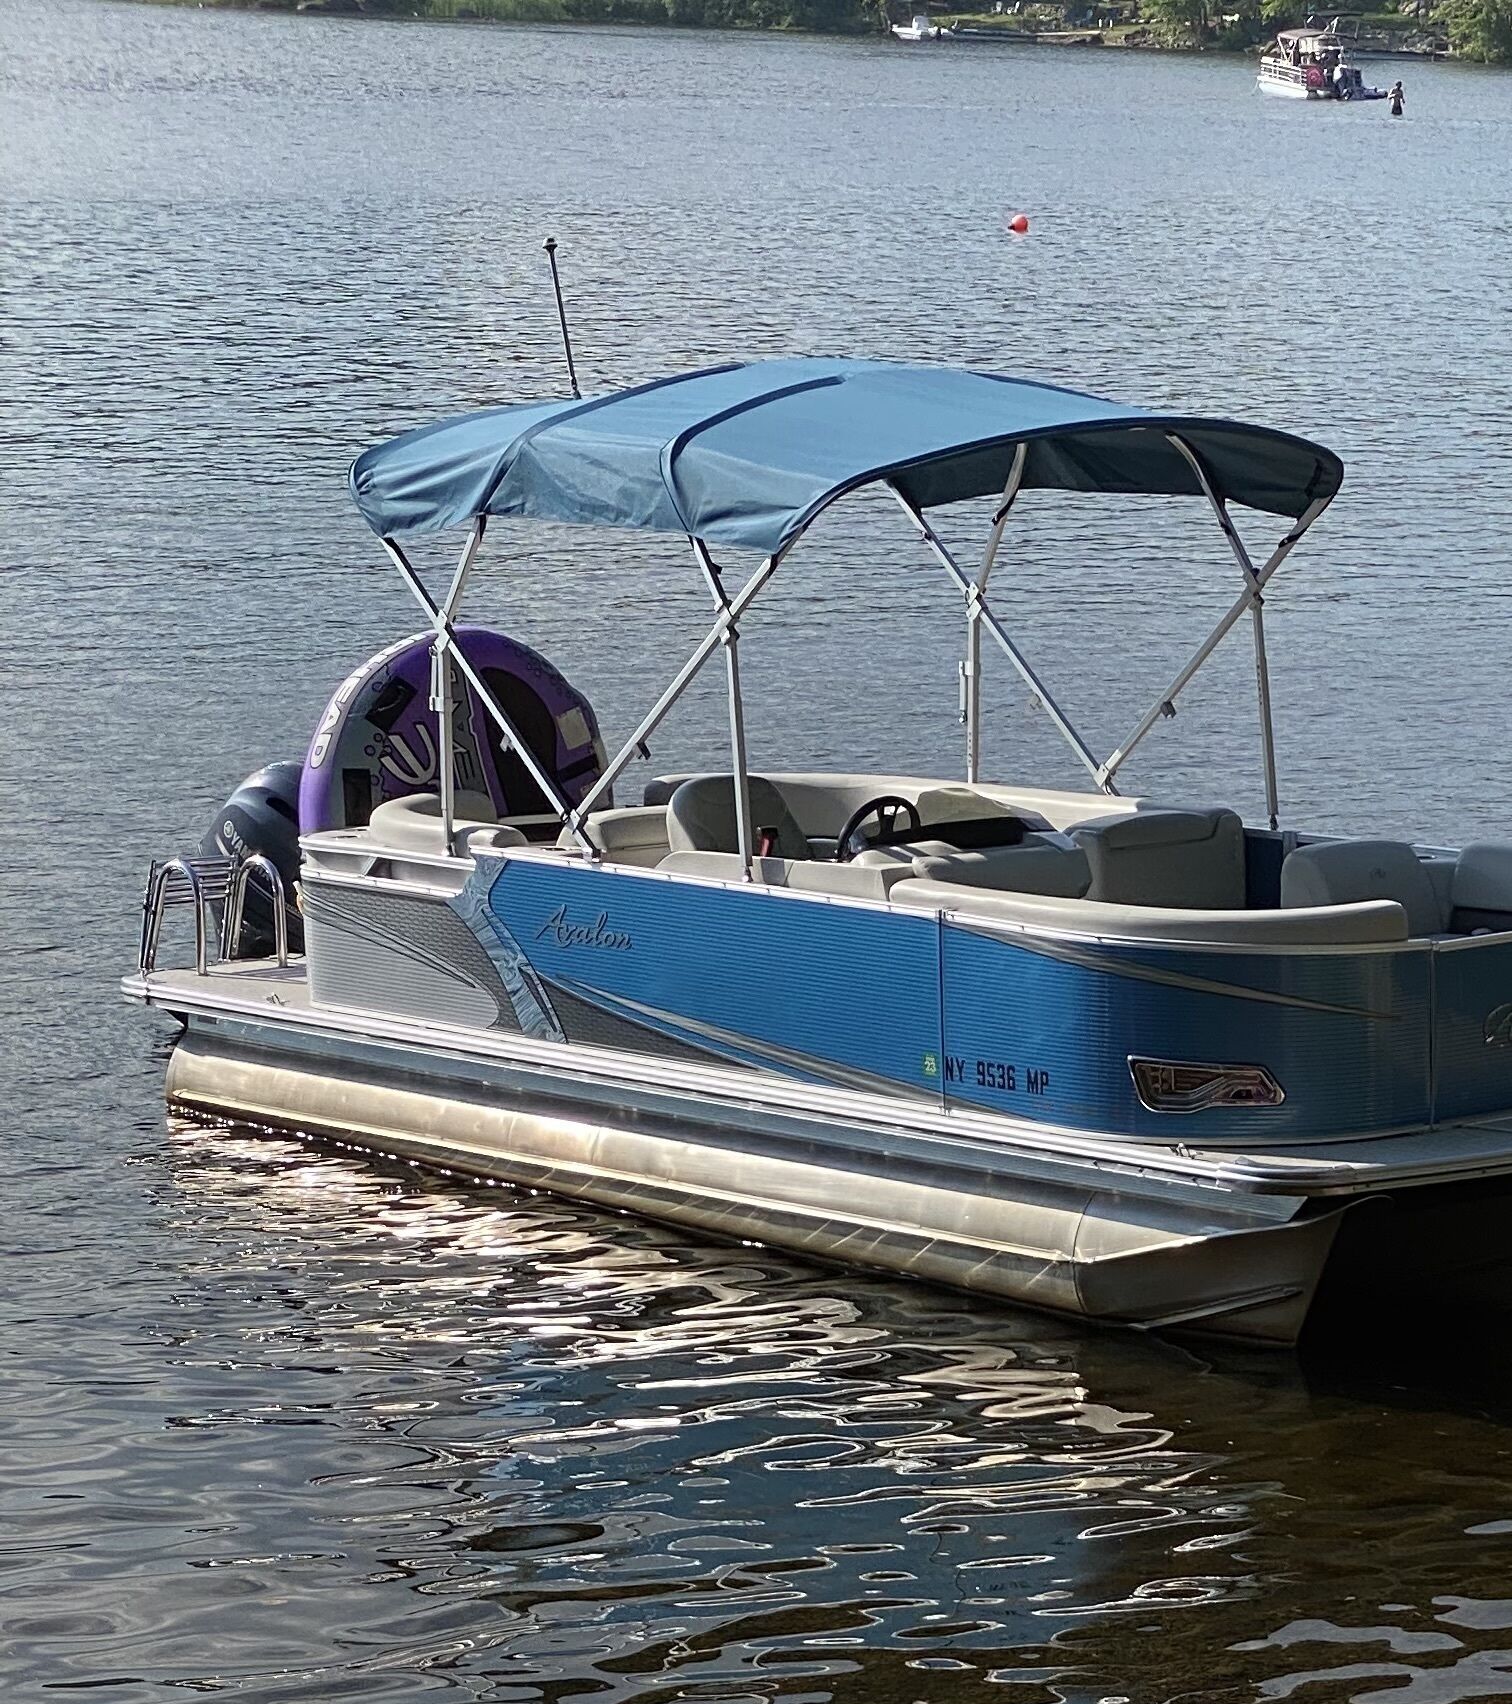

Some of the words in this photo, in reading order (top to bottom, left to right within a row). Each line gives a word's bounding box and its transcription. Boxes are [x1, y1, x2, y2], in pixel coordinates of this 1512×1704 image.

[535, 903, 632, 951] Avalon
[945, 1055, 966, 1083] NY
[976, 1060, 1016, 1091] 9536
[1026, 1067, 1050, 1095] MP
